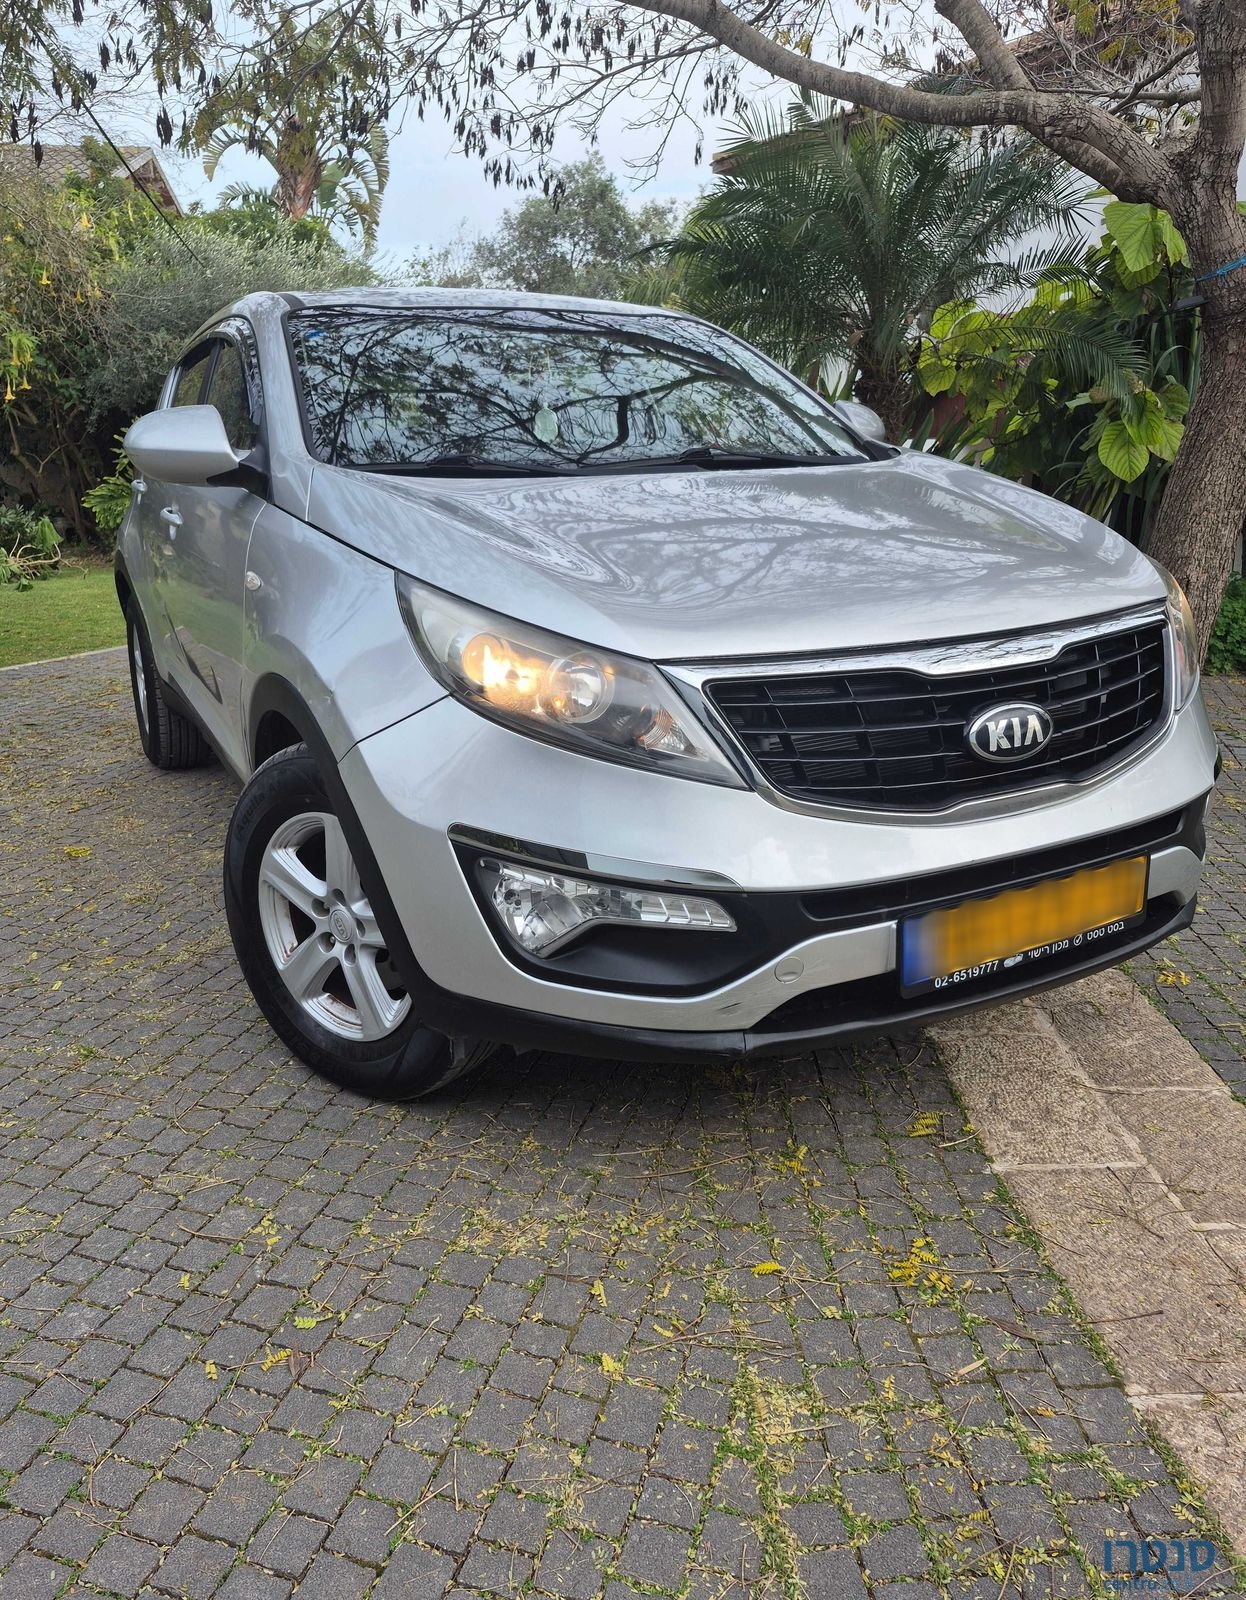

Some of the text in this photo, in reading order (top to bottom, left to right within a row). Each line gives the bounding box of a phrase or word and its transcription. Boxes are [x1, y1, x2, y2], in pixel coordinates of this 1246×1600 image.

[985, 714, 1044, 752] KIA
[934, 921, 1125, 988] בסט טסט מכון רישוי 02-6519777
